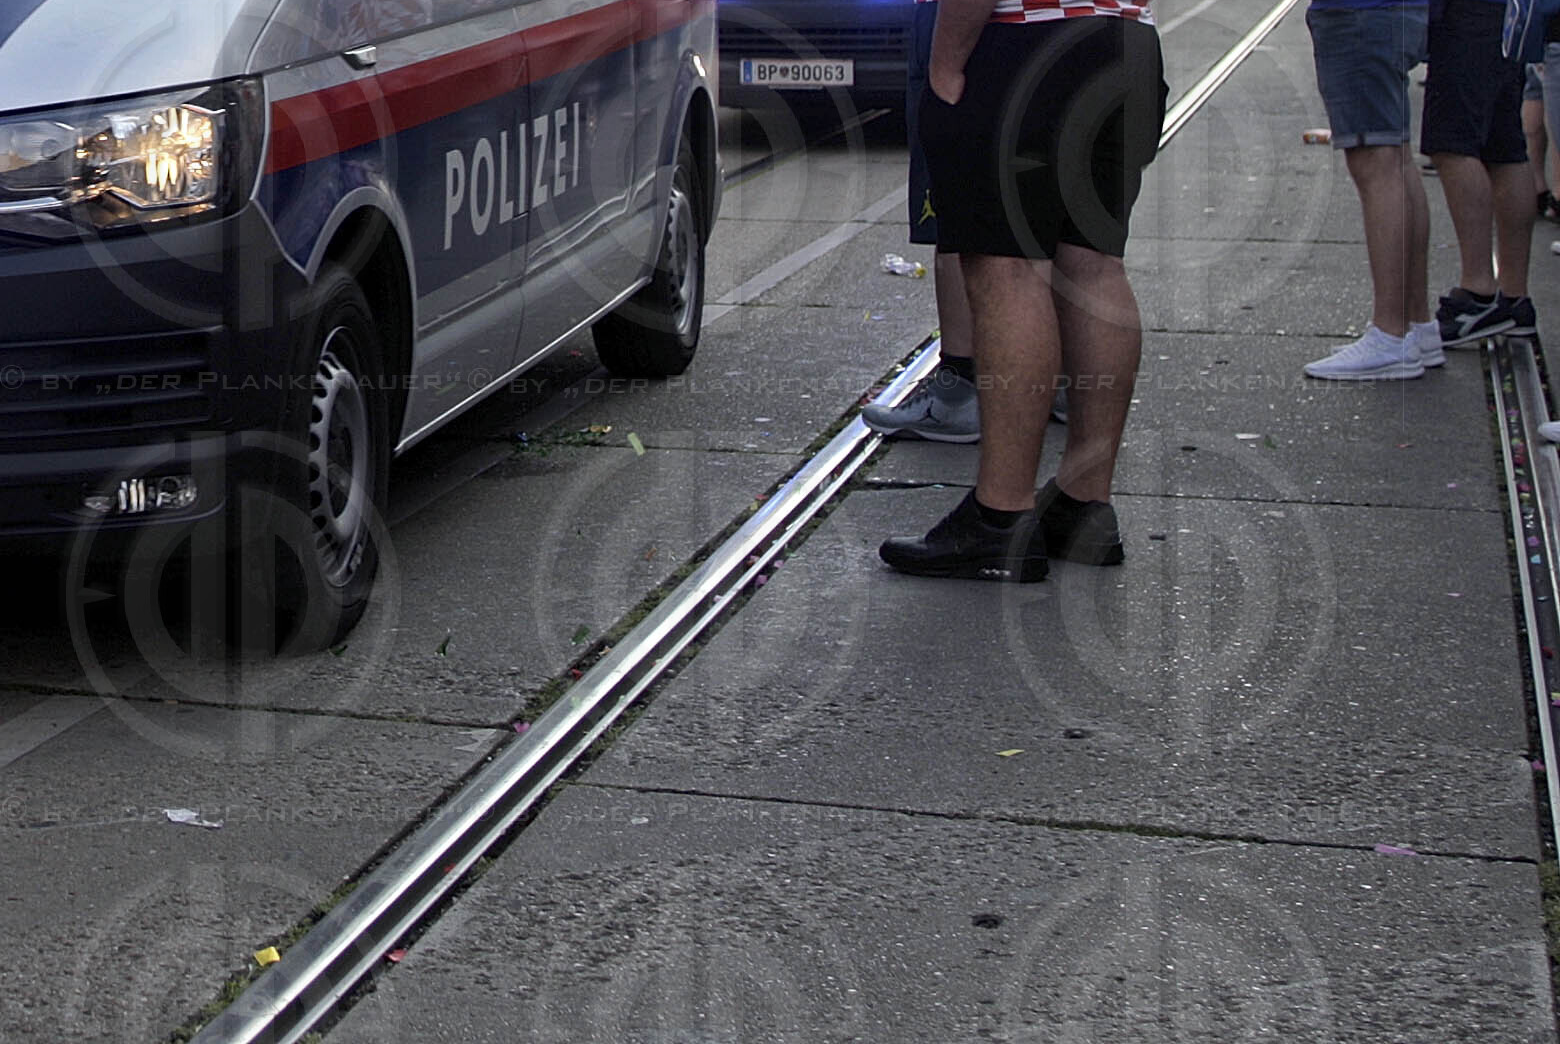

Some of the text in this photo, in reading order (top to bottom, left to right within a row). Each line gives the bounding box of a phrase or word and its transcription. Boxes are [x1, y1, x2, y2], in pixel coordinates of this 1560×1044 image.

[757, 64, 778, 80] BP
[790, 64, 845, 82] 90063
[443, 101, 580, 250] POLIZEI
